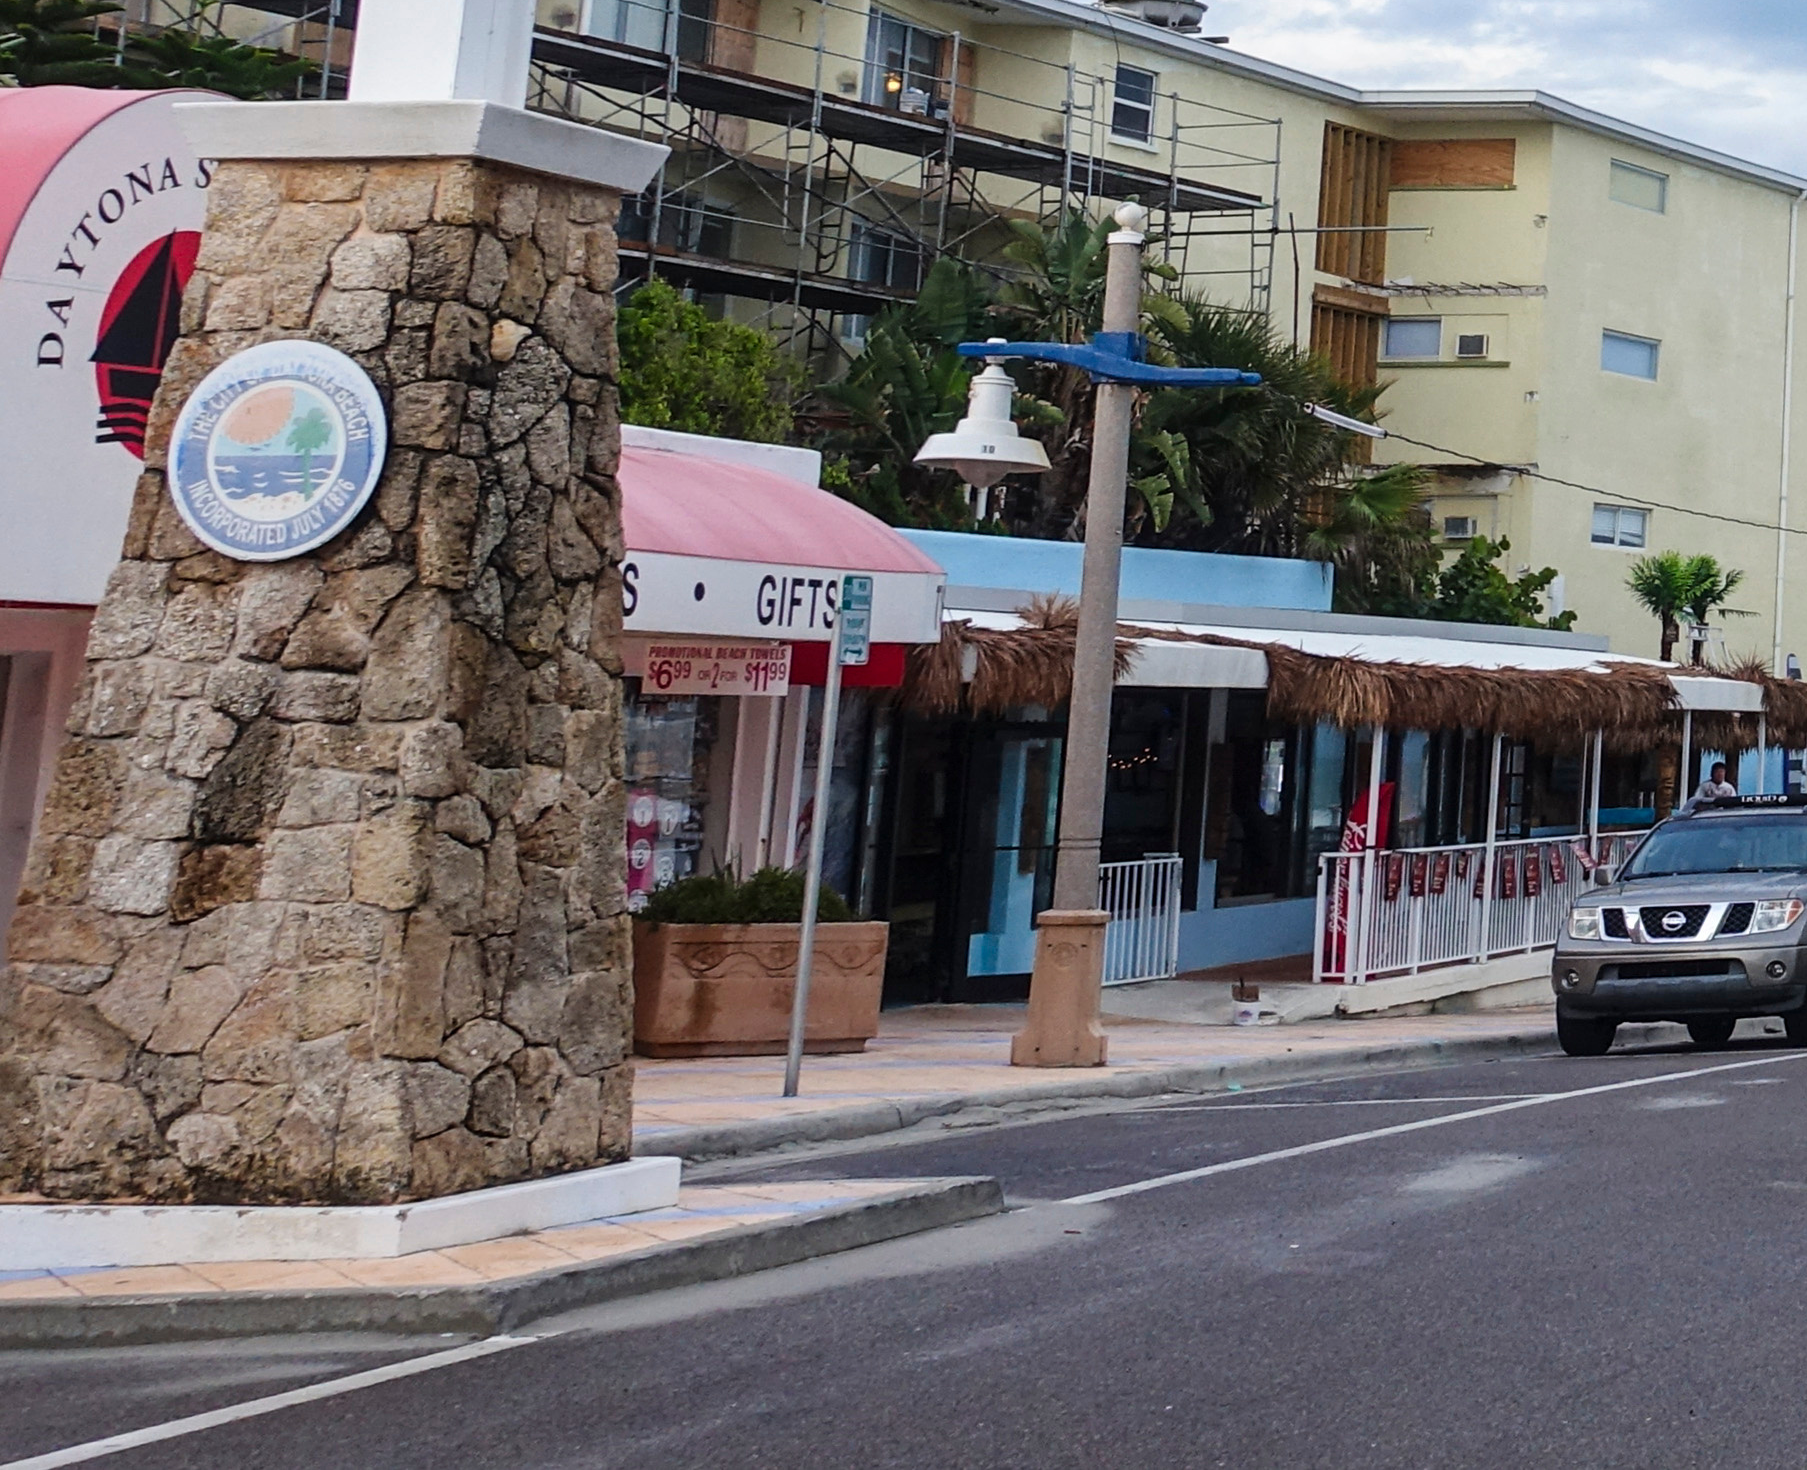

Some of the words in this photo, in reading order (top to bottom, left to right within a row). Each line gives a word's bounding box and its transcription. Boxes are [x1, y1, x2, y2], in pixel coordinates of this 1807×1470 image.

[37, 157, 182, 368] DAYTONA
[335, 389, 369, 441] BEACH
[188, 479, 287, 545] INCORPORATED
[291, 506, 326, 540] JULY
[324, 478, 356, 514] 1876
[757, 574, 839, 629] GIFTS
[648, 646, 713, 659] PROMOTIONAL
[715, 647, 747, 660] BEACH
[751, 648, 787, 660] TOWELS
